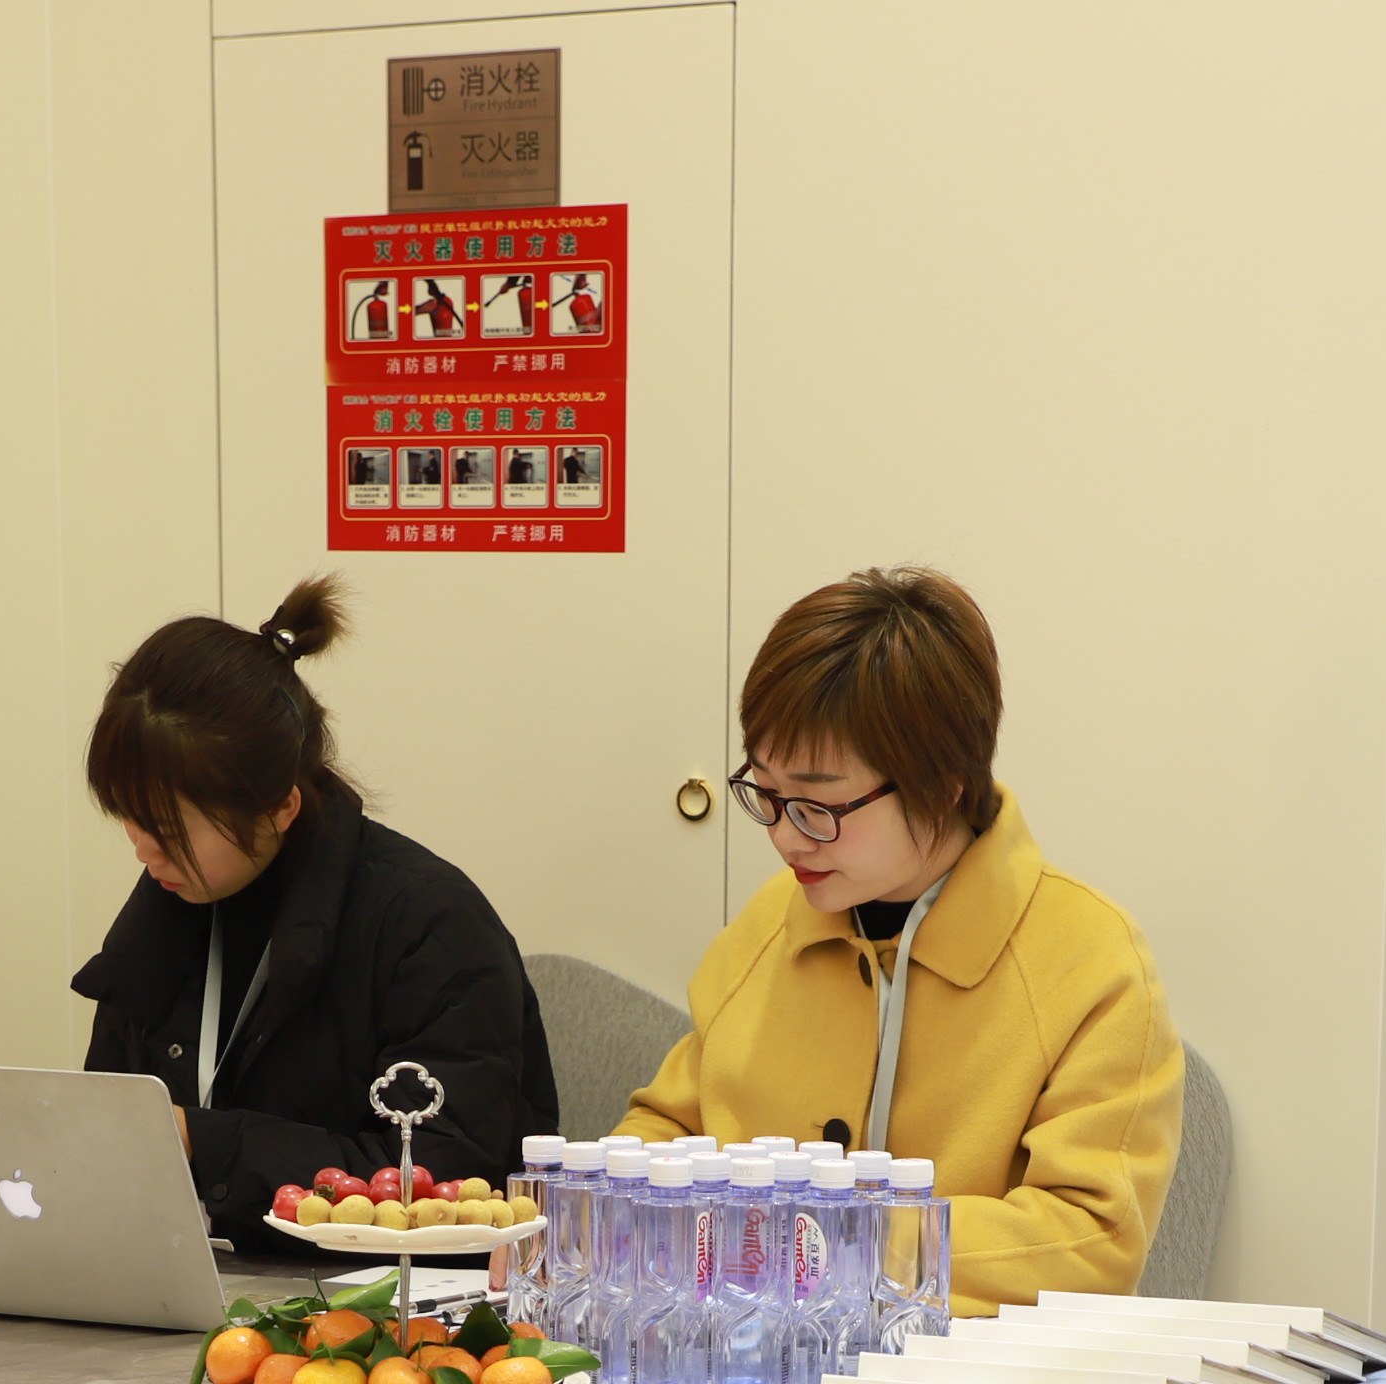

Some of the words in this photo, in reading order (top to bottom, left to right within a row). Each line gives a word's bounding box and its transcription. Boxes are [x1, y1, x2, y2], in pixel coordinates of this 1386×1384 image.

[459, 62, 540, 97] 消火栓
[463, 99, 486, 112] Fire
[487, 98, 537, 112] Hydrant
[460, 131, 540, 164] 灭火器
[374, 233, 577, 262] 灭火器使用方法
[386, 356, 457, 375] 消防器材
[492, 353, 566, 372] 严禁挪用
[373, 408, 576, 432] 消火栓使用方法
[386, 525, 457, 542] 消防器材
[492, 524, 564, 542] 严禁挪用
[795, 1216, 807, 1284] Ganten
